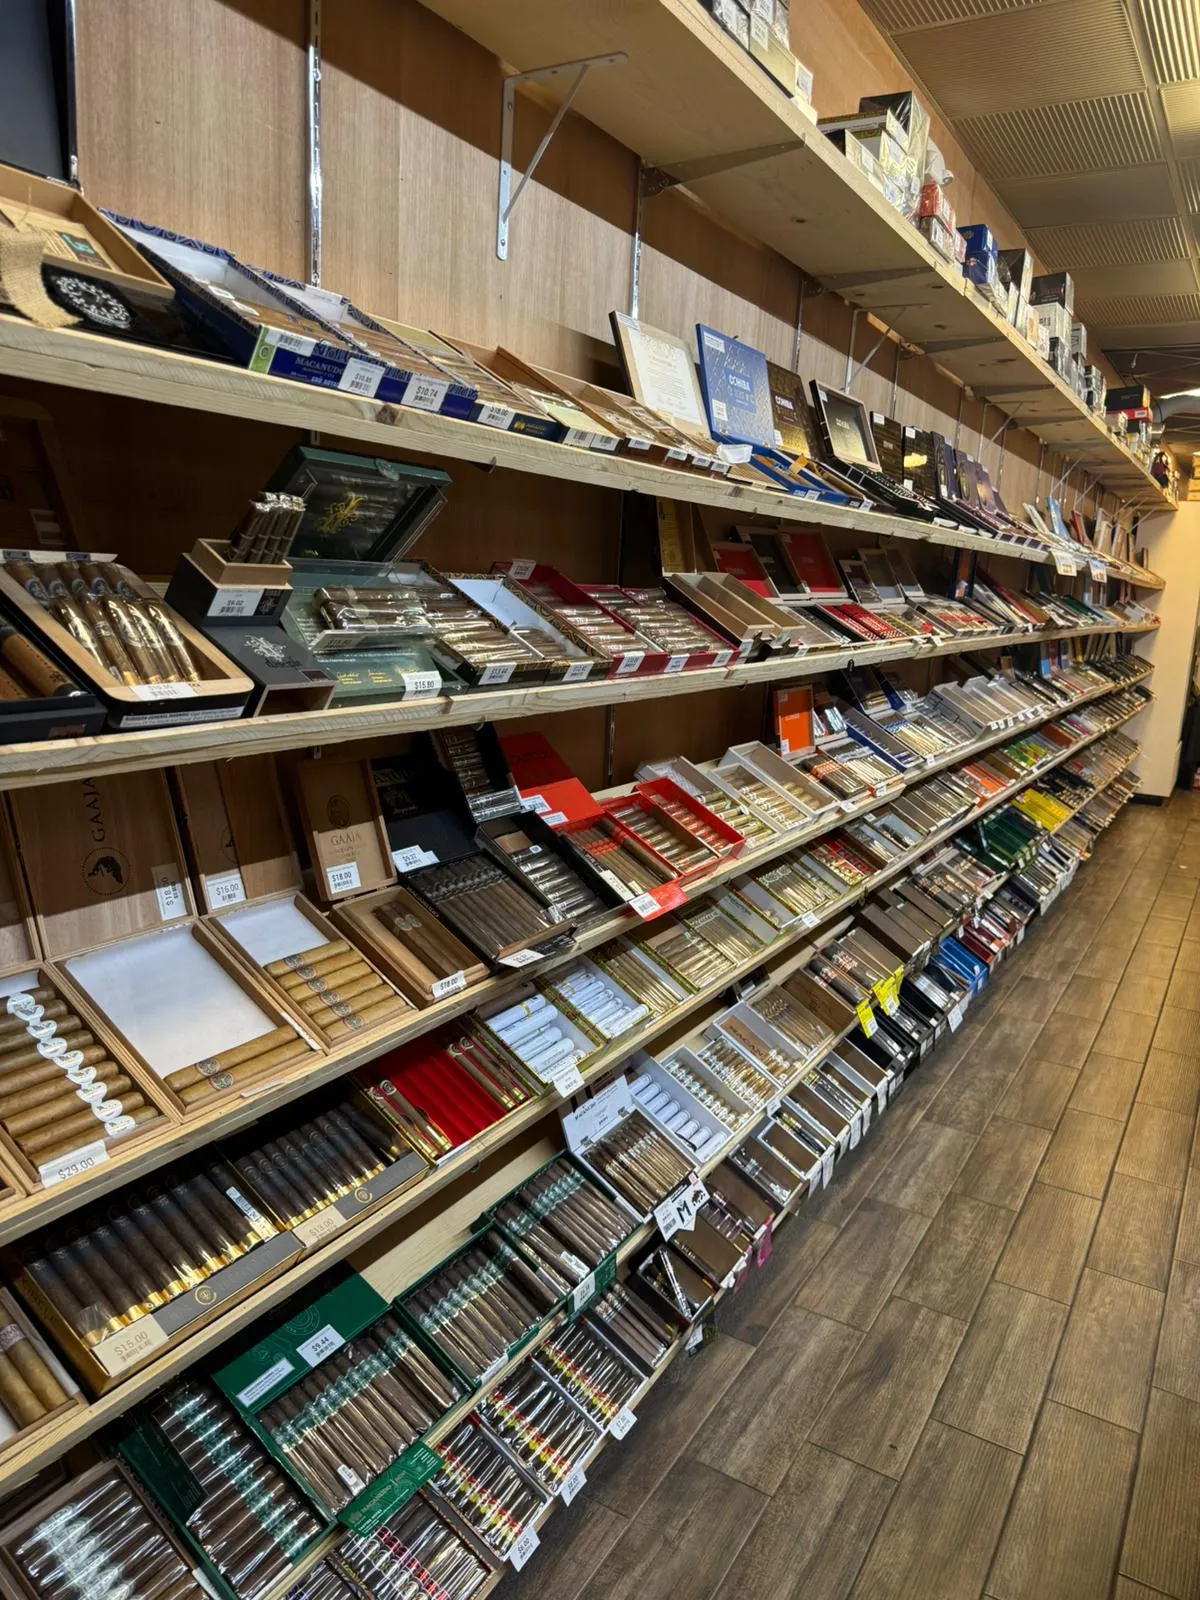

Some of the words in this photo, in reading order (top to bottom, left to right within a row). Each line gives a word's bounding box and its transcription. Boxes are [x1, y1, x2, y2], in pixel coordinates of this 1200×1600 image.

[416, 386, 439, 398] $10.74
[216, 883, 240, 896] $16.00
[58, 1157, 95, 1180] $29.00
[676, 1200, 692, 1224] M
[311, 1336, 330, 1352] $9.44
